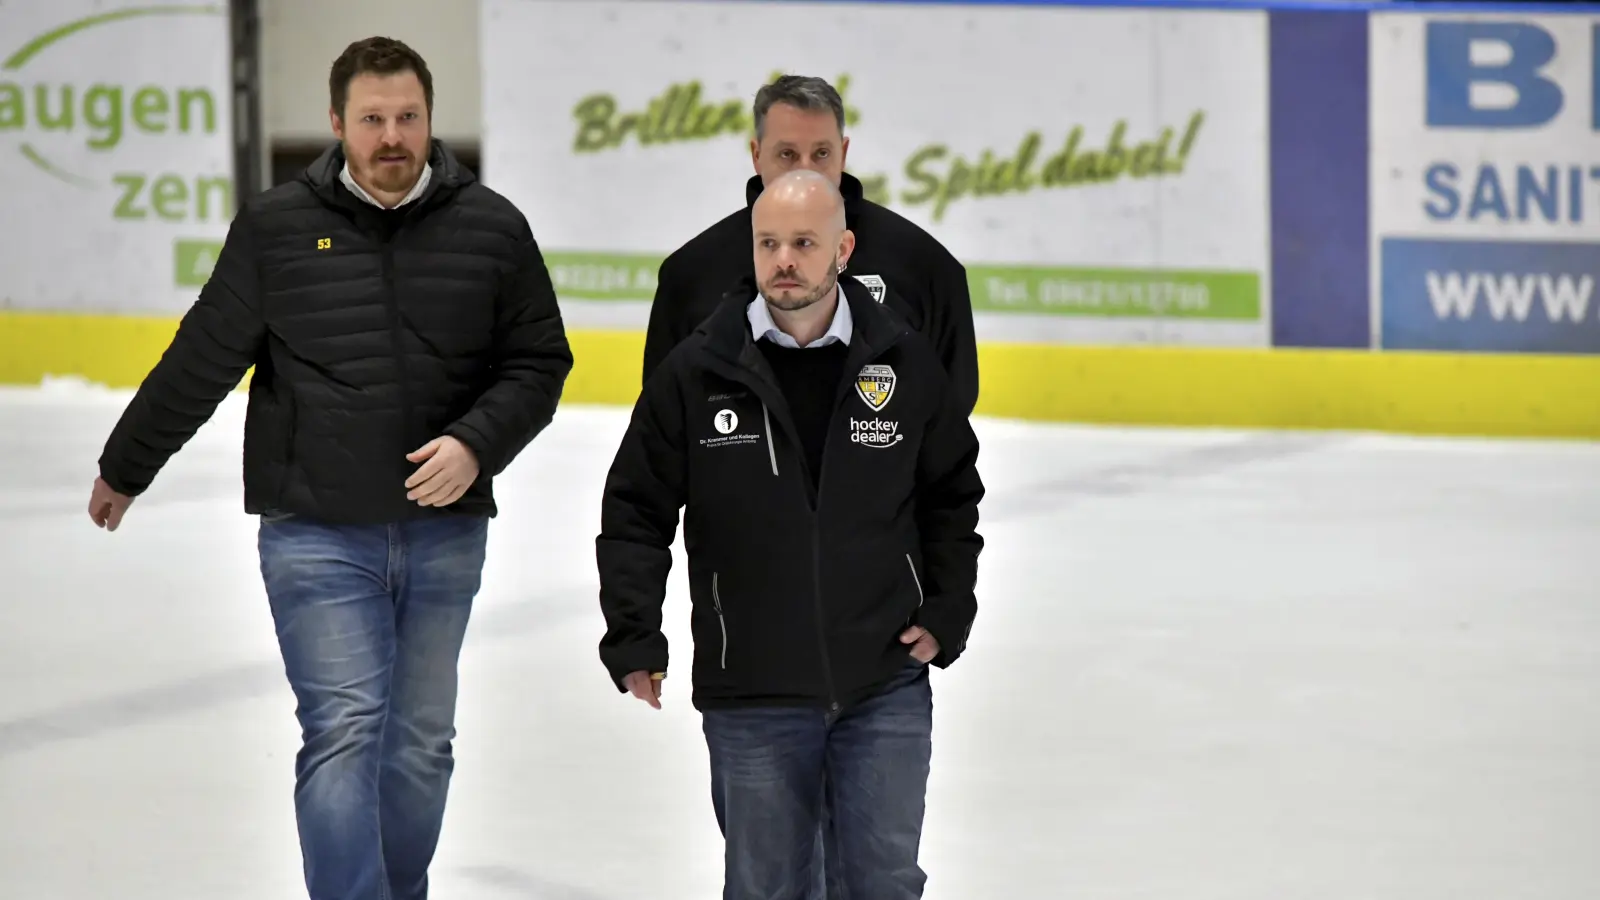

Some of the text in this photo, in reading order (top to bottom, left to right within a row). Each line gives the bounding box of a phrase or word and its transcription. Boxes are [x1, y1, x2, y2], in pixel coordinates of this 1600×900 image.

[1425, 20, 1600, 131] B
[0, 82, 216, 149] augen
[902, 109, 1205, 223] Spiel dabei!
[112, 172, 231, 221] zen
[317, 237, 331, 249] 53
[1425, 269, 1600, 324] www
[850, 417, 898, 437] hockey
[850, 430, 892, 443] dealer
